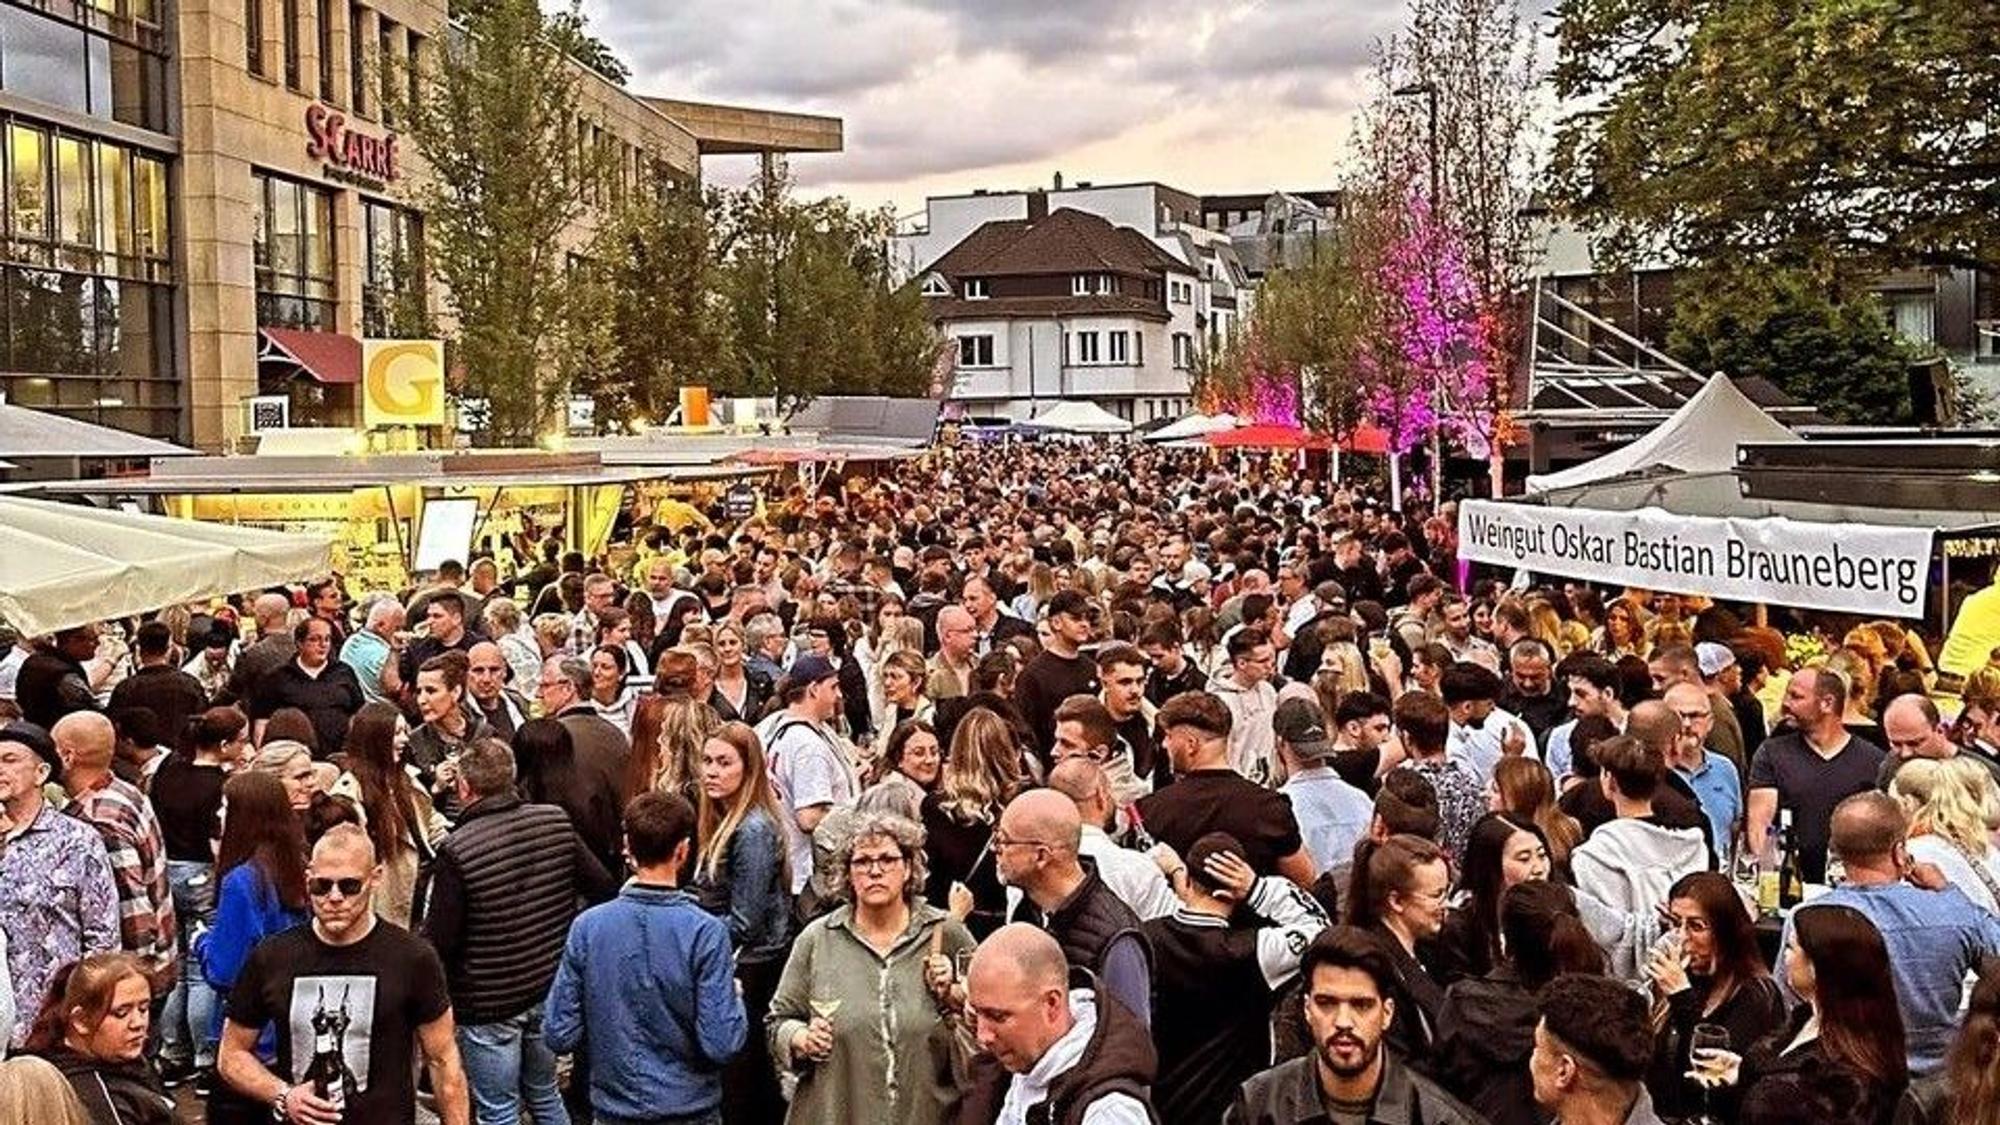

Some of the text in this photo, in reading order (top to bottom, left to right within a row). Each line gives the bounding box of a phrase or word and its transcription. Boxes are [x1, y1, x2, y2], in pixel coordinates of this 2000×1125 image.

[367, 344, 439, 416] G
[1468, 514, 1546, 560] Weingut
[1552, 523, 1615, 564] Oskar
[1624, 531, 1714, 577] Bastian
[1727, 539, 1918, 604] Brauneberg
